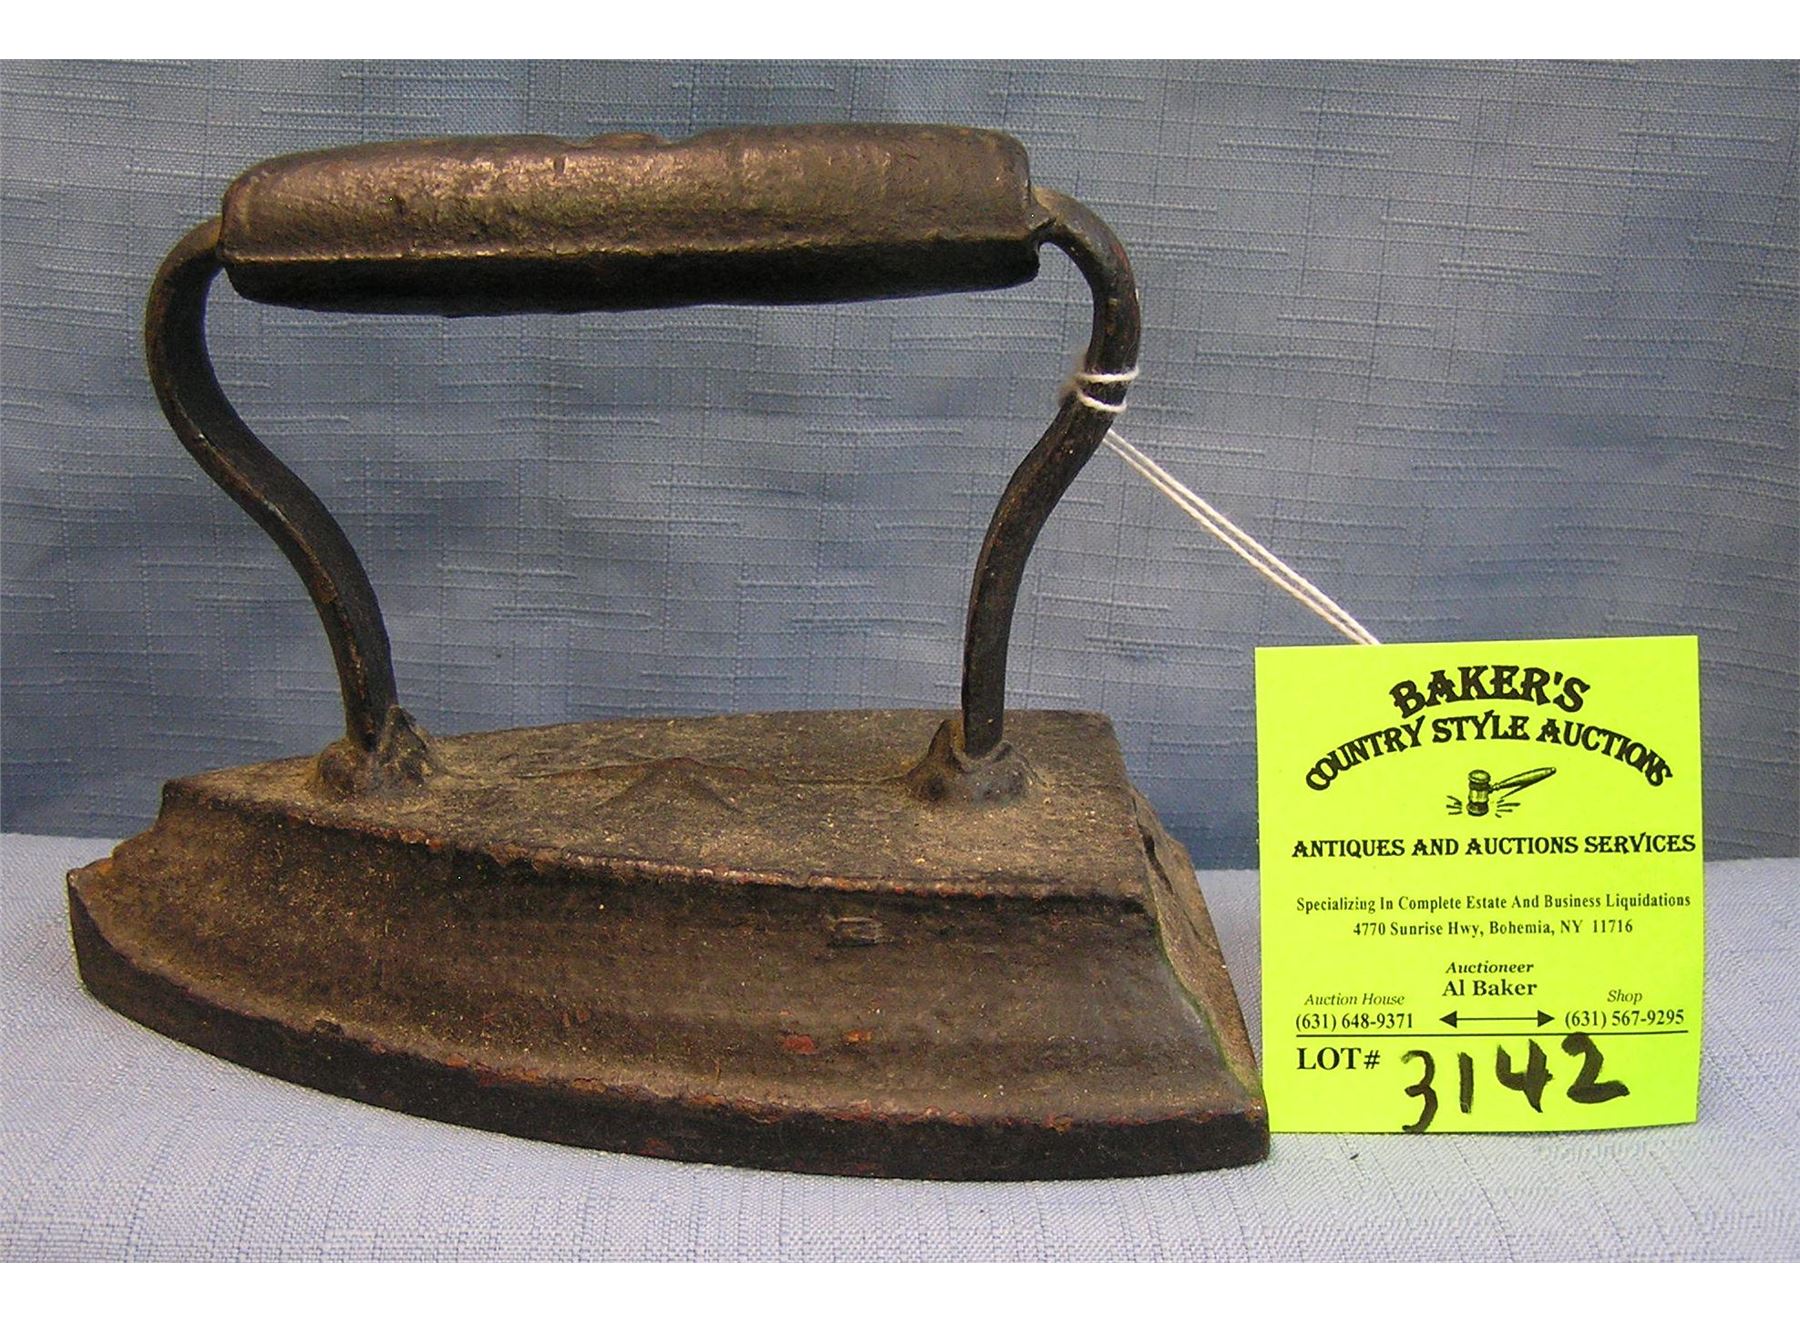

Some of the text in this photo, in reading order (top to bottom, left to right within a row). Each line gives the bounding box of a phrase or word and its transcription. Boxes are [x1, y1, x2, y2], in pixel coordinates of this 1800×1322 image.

[1389, 665, 1591, 718] BAKER'S
[1306, 710, 1673, 791] COUNTRY STYLE AUCTIONS
[1291, 832, 1696, 859] ANTIQUES AND AUCTIONS SERVICES
[1296, 892, 1691, 915] Specializing In Complete Estate And Business Liquidations
[1353, 919, 1633, 939] 4770 Sunrise Hwy, Bohemia, NY 11716
[1445, 960, 1534, 974] Auctioneer
[1442, 978, 1538, 997] Al Baker
[1607, 989, 1643, 1005] Shop
[1305, 992, 1405, 1006] Auction House
[1295, 1012, 1414, 1032] (631) 648-9371
[1564, 1008, 1684, 1029] (631) 567-9295
[1297, 1047, 1380, 1070] LOT#
[1400, 1031, 1631, 1133] 3142
